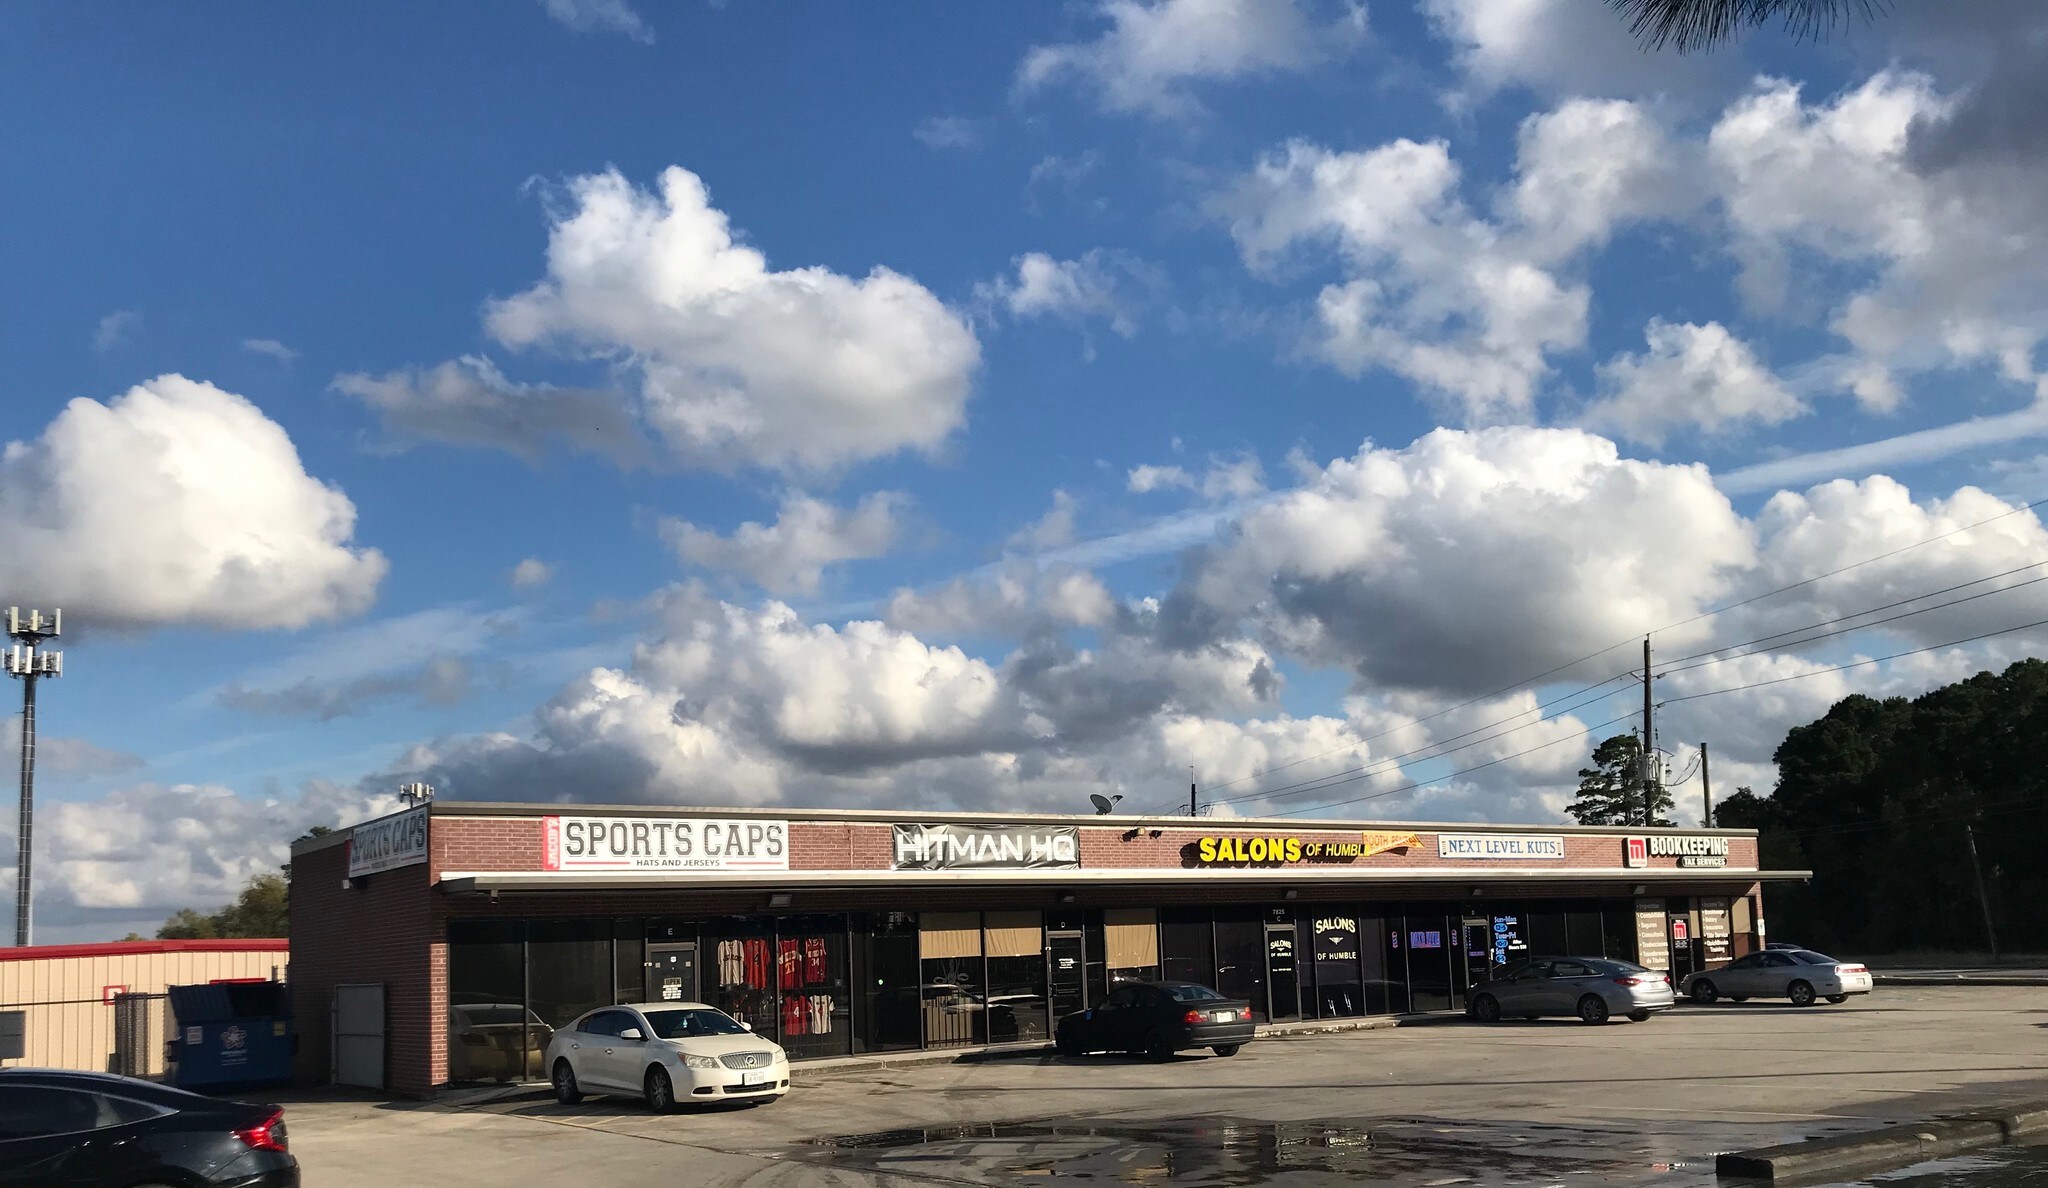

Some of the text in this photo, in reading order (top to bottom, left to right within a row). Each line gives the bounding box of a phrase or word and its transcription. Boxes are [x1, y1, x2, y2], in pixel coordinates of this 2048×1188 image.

[393, 811, 426, 855] CAPS
[565, 820, 783, 858] SPORTS CAPS
[897, 834, 1077, 862] HITMAN HQ
[1200, 838, 1300, 862] SALONS
[1306, 843, 1321, 857] OF
[1449, 840, 1556, 854] NEXT LEVEL KUTS
[1650, 837, 1729, 855] BOOKKEEPING
[636, 859, 720, 867] HATS AND JERSEYS
[1684, 858, 1725, 866] TAX SERVICES
[1315, 917, 1356, 934] SALONS
[1270, 940, 1292, 949] SALONS
[1329, 951, 1356, 960] HUMBLE
